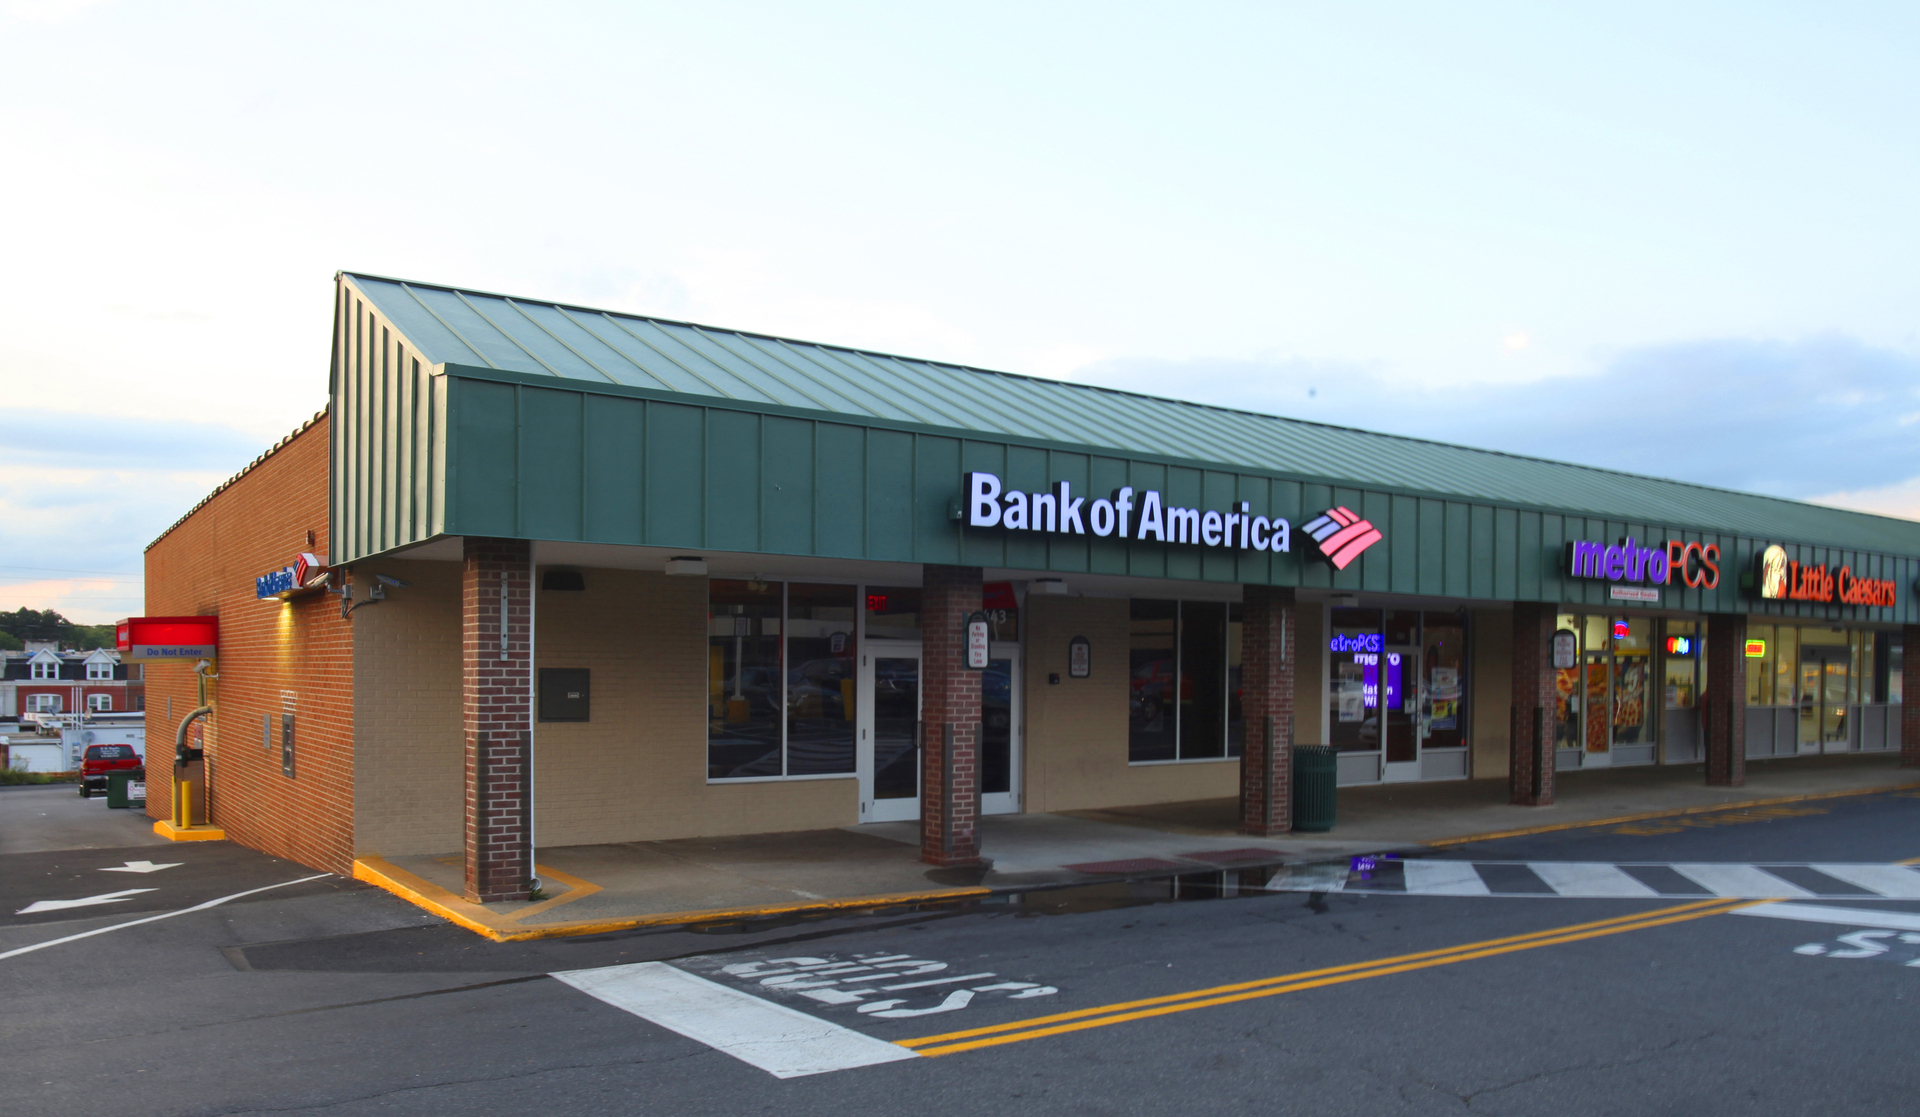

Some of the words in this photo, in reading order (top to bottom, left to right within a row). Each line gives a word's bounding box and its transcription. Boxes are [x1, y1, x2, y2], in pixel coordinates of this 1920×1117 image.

[969, 471, 1086, 535] Bank
[1090, 486, 1134, 538] of
[1137, 490, 1290, 554] America
[1571, 535, 1720, 590] metroPCS
[1789, 560, 1835, 603] Little
[1838, 564, 1897, 608] Caesars
[868, 595, 887, 611] EXIT
[147, 648, 159, 656] Do
[162, 648, 177, 656] Not
[180, 648, 202, 656] Enter
[1353, 653, 1401, 667] meo
[721, 953, 1059, 1019] STOP
